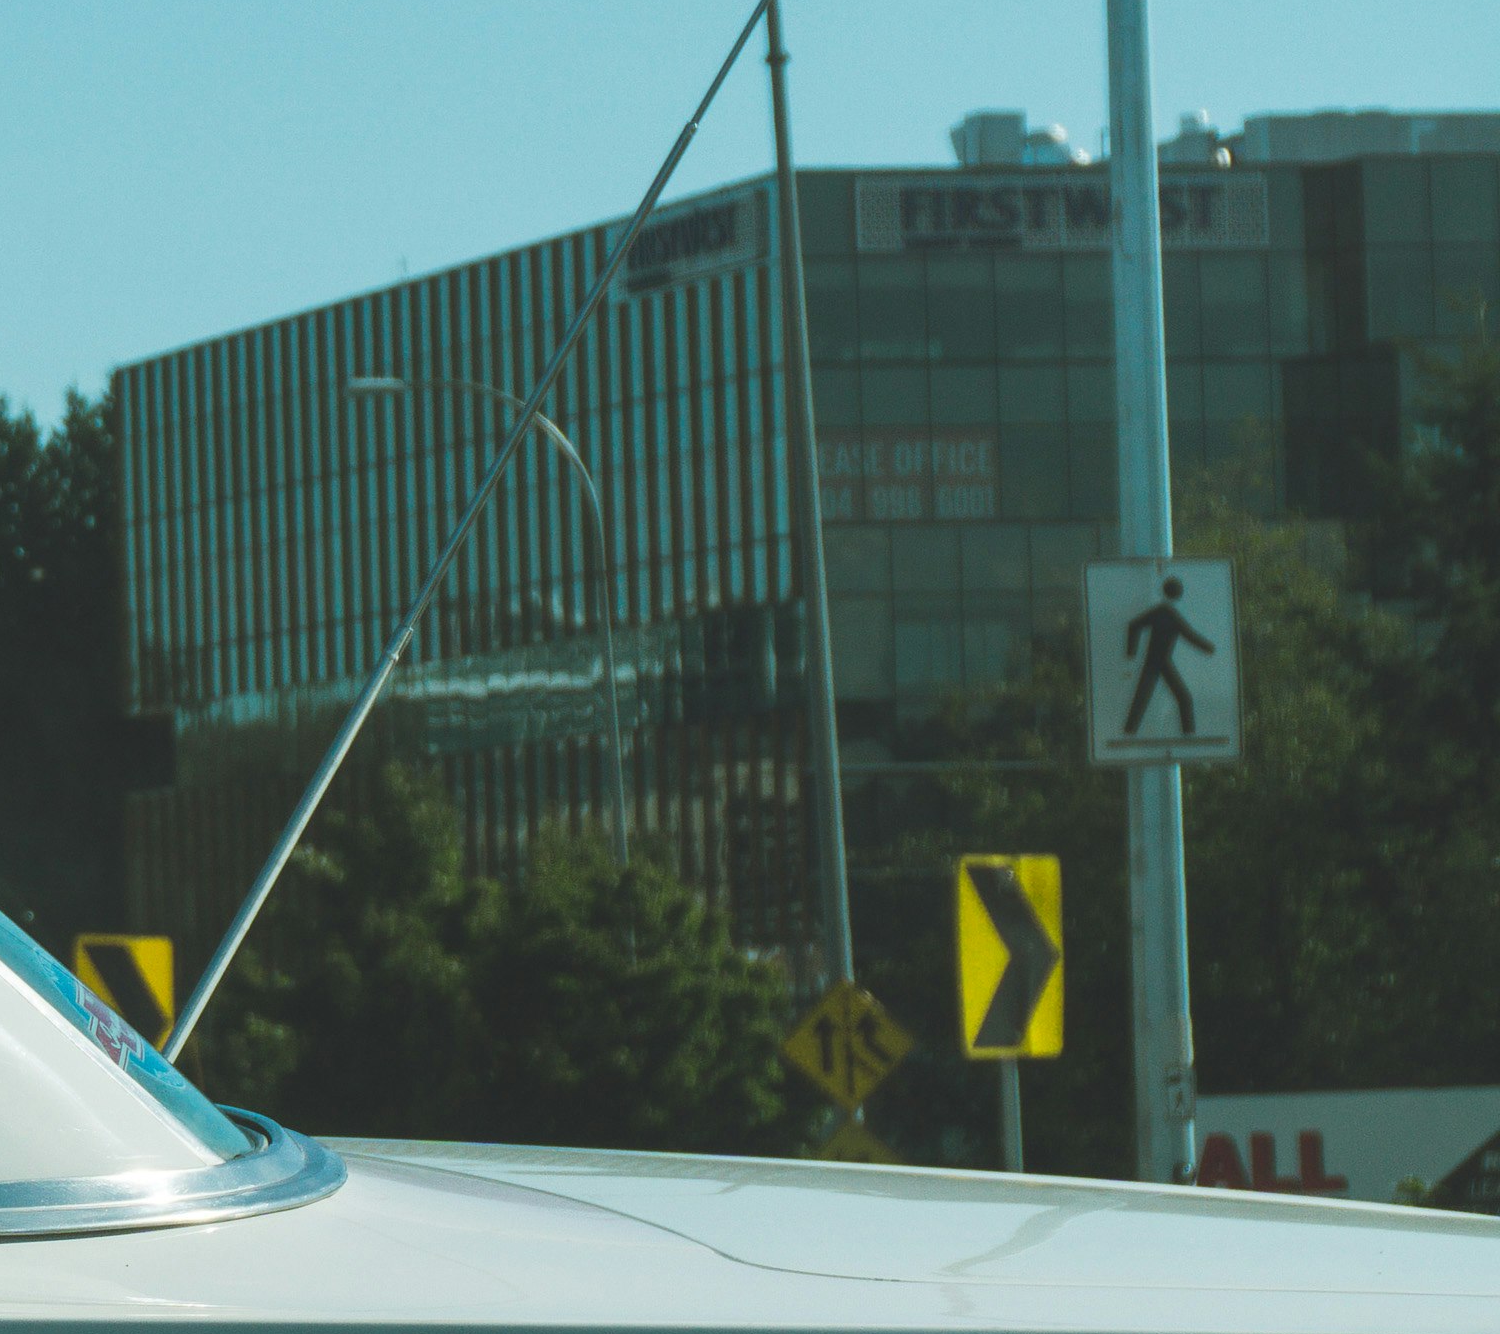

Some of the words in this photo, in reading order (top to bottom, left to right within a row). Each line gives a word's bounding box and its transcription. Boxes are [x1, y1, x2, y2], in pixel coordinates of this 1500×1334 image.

[818, 441, 885, 476] EASE
[892, 441, 994, 476] OFFICE
[820, 484, 853, 520] 04
